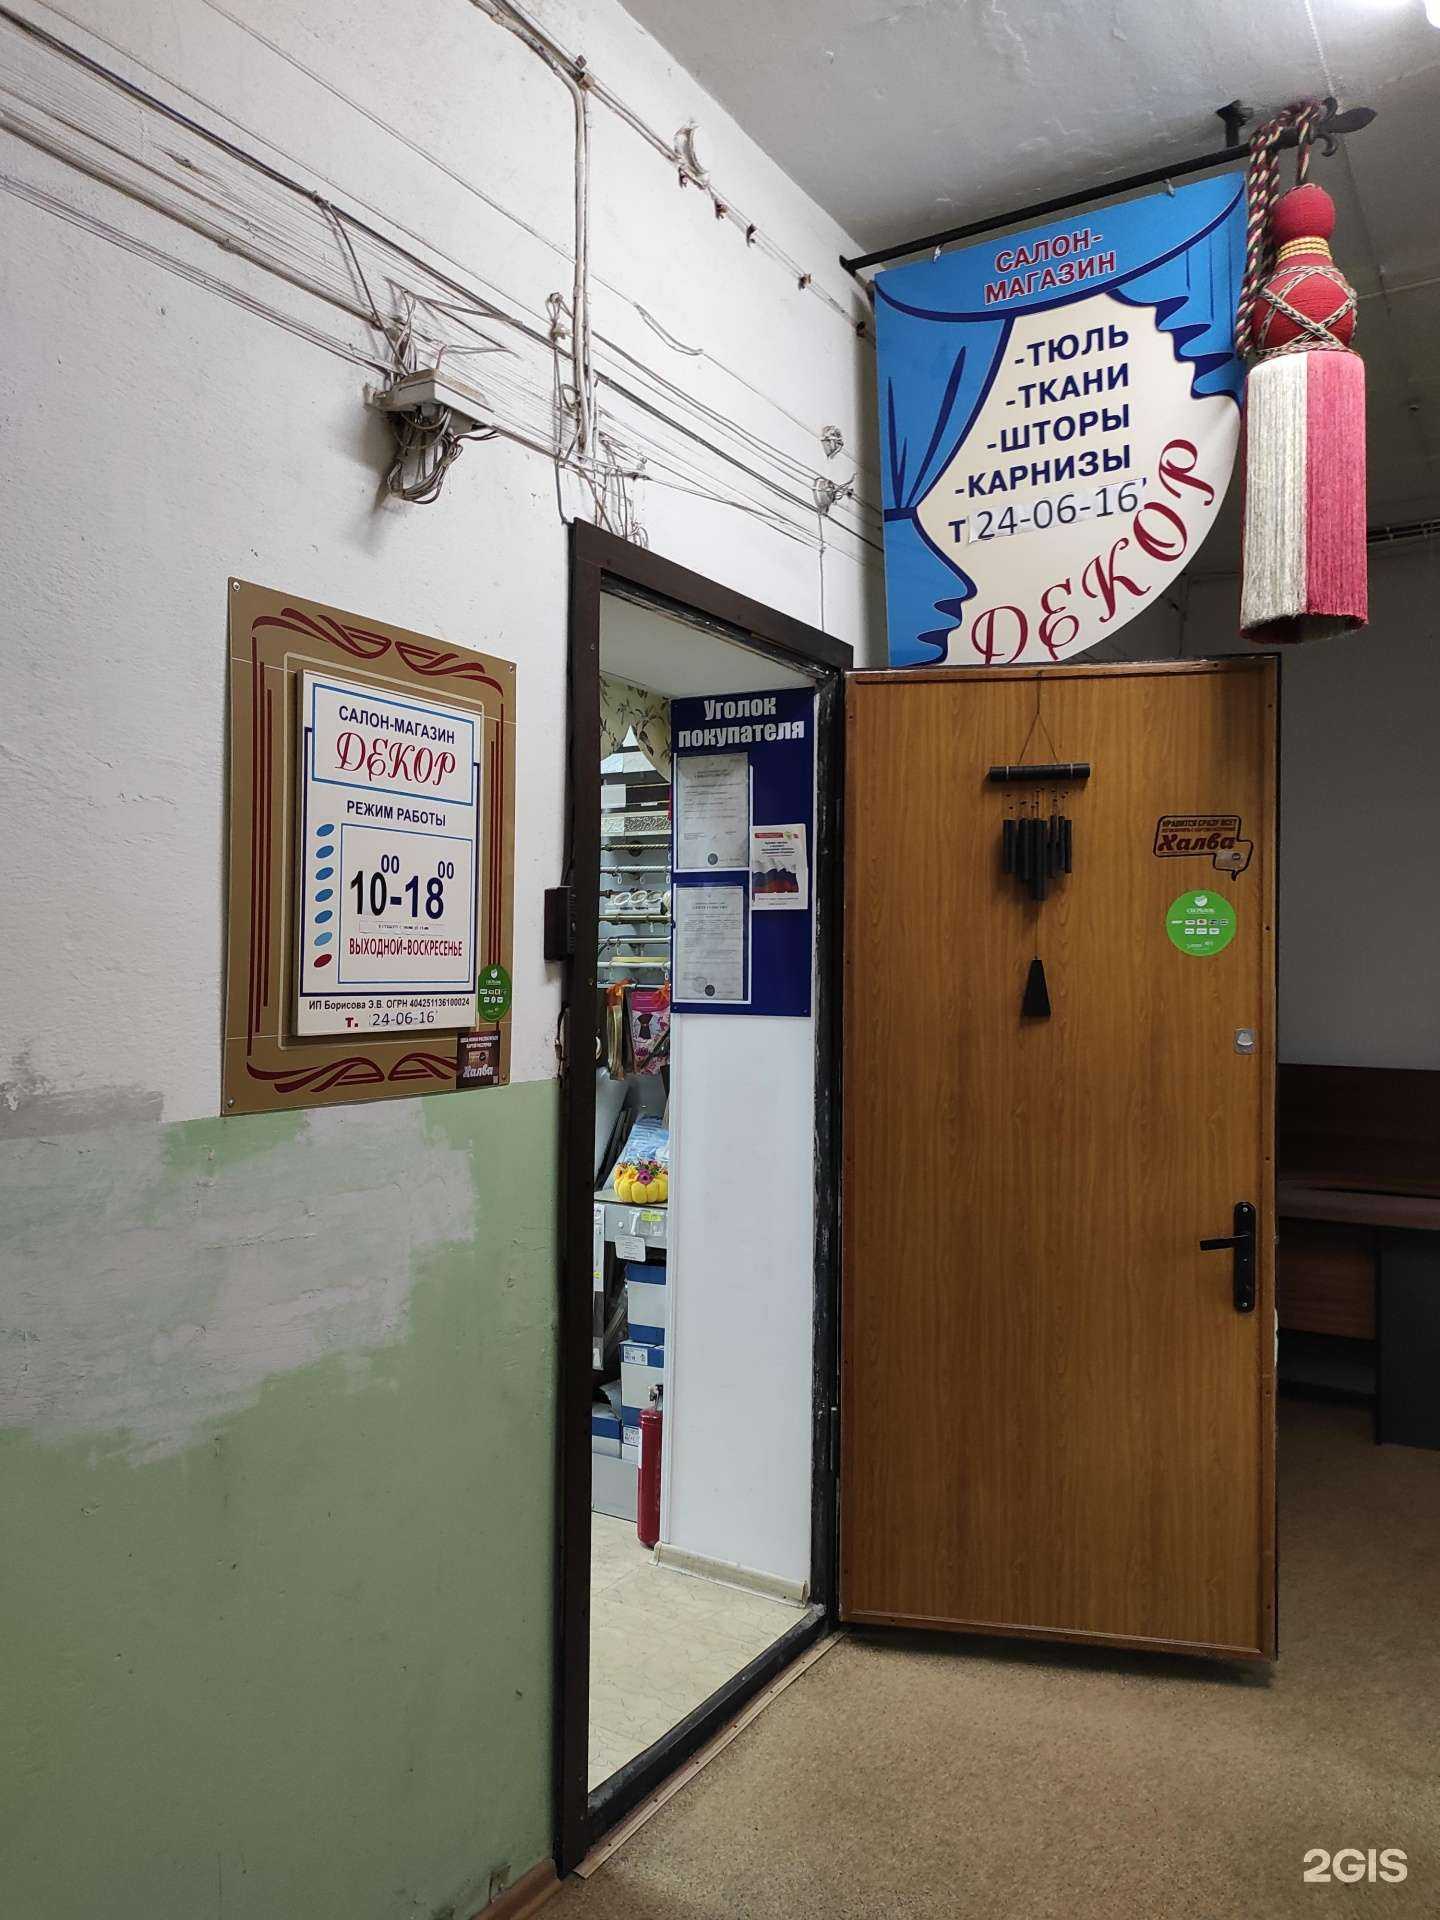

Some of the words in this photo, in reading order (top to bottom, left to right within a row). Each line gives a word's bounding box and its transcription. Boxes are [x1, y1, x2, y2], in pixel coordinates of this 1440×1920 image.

[995, 228, 1103, 274] САЛОН-
[984, 251, 1116, 306] МАГАЗИН
[971, 439, 1215, 664] ДЕКОР
[704, 697, 776, 721] Уголок
[339, 705, 455, 744] САЛОН-МАГАЗИН
[678, 720, 805, 748] покупателя
[334, 732, 456, 785] ДЕКОР
[346, 800, 393, 820] РЕЖИМ
[397, 806, 446, 826] РАБОТЫ
[1157, 833, 1235, 851] Халва
[349, 937, 463, 958] ВЫХОДНОЙ-ВОСКРЕСЕНЬЕ
[309, 1000, 322, 1010] ИП
[325, 1000, 366, 1011] Борисова
[386, 999, 407, 1009] ОГРН
